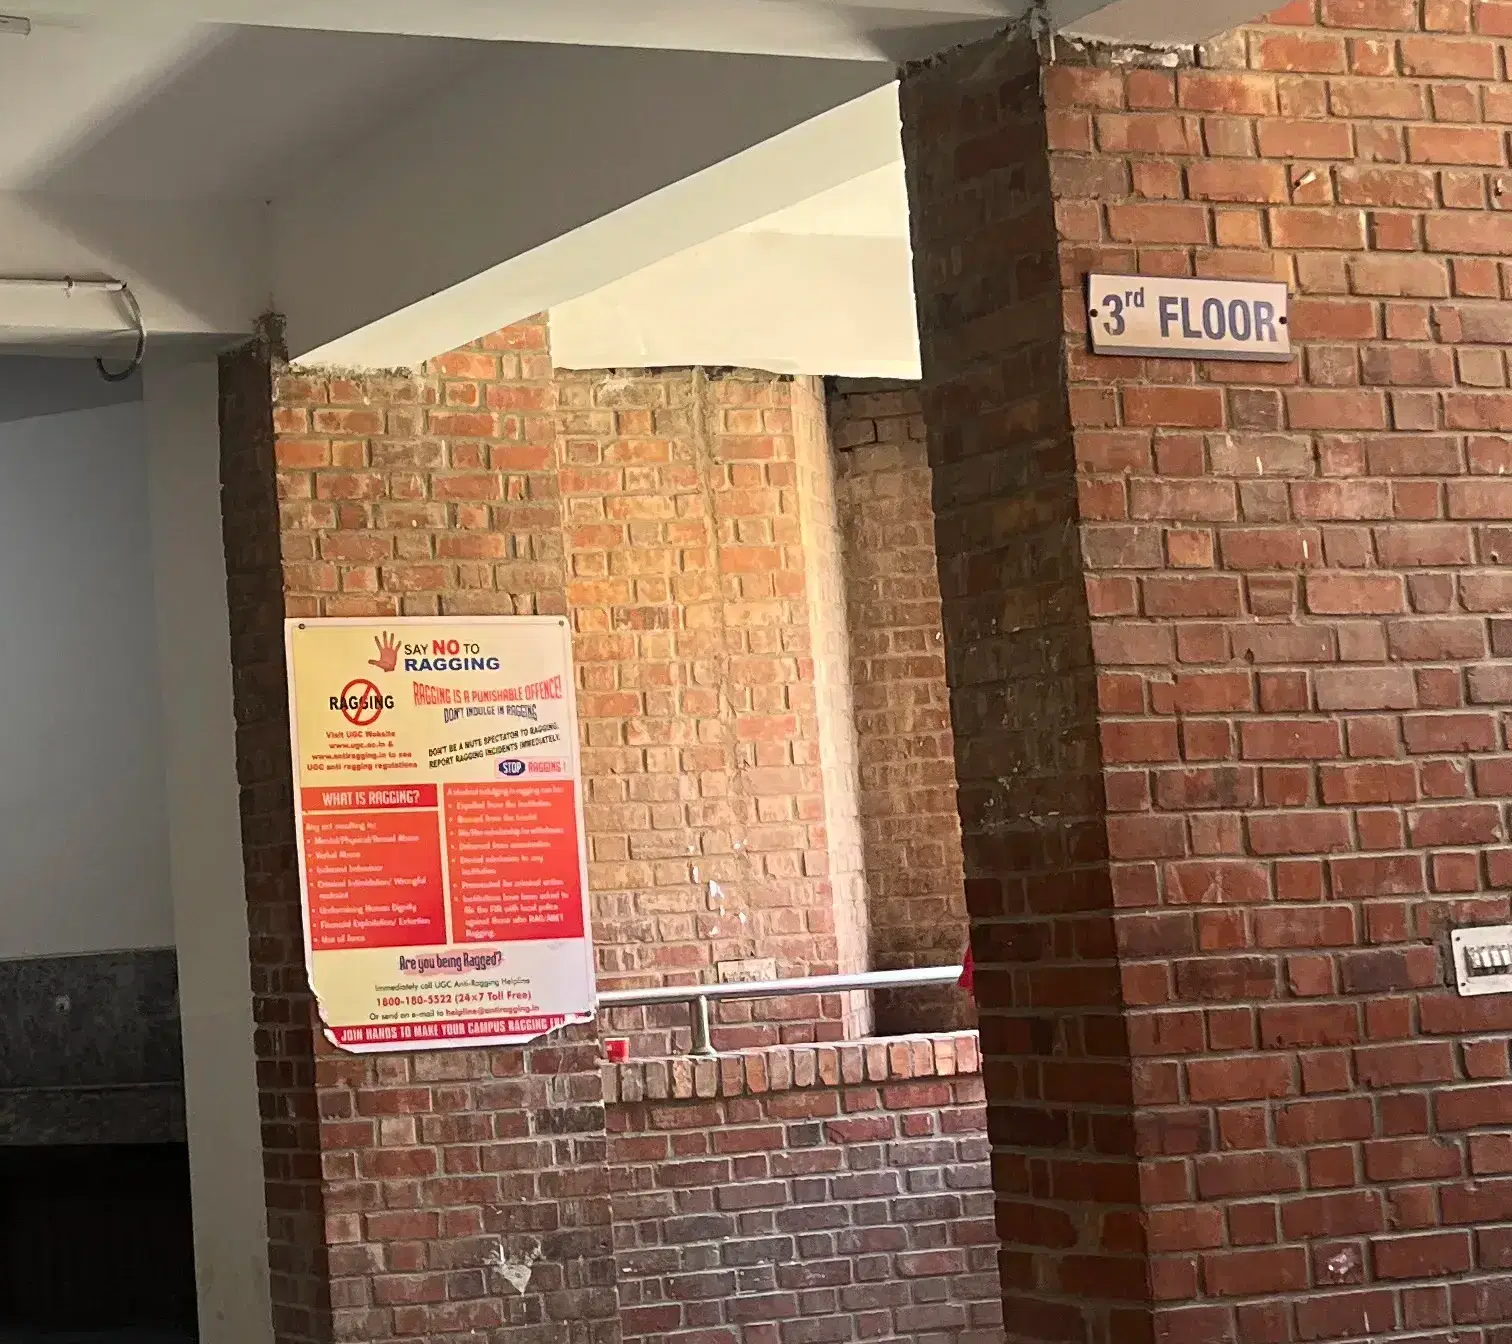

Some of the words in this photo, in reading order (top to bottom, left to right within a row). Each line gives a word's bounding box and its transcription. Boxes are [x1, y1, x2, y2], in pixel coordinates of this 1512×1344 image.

[1158, 295, 1277, 342] FLOOR
[404, 644, 428, 656] SAY
[432, 639, 460, 655] NO
[463, 643, 480, 655] TO
[404, 657, 500, 671] RAGGING
[413, 680, 451, 706] RAGGING
[453, 688, 462, 704] IS
[464, 690, 470, 703] A
[471, 686, 523, 703] PUNISHABLE
[524, 675, 563, 700] OFFENCE!
[329, 695, 395, 711] RAGGING
[444, 707, 464, 723] DON'T
[466, 706, 496, 718] INDULGE
[326, 731, 344, 739] Visit
[448, 742, 458, 752] BE
[459, 742, 464, 750] A
[483, 729, 519, 745] SPECTATOR
[520, 728, 529, 737] TO
[429, 758, 454, 769] REPORT
[455, 750, 484, 763] RAGGING
[485, 742, 518, 756] INCIDENTS
[307, 763, 325, 771] UGC
[343, 762, 373, 772] ragging
[503, 760, 522, 774] STOP
[322, 791, 353, 806] WHAT
[355, 791, 366, 805] IS
[368, 790, 420, 805] RAGGING?
[399, 955, 416, 970] Are
[418, 958, 435, 973] you
[436, 953, 462, 972] being
[463, 951, 502, 971] Ragged?
[375, 982, 418, 992] Immediately
[420, 981, 432, 990] call
[435, 980, 452, 989] UGC
[487, 990, 504, 1001] Toll
[507, 990, 532, 1001] Free)
[381, 1011, 399, 1020] send
[341, 1029, 363, 1042] JOIN
[365, 1026, 398, 1040] HANDS
[400, 1025, 411, 1038] TO
[413, 1024, 439, 1037] MAKE
[440, 1022, 466, 1036] YOUR
[467, 1020, 506, 1035] CAMPUS
[508, 1018, 548, 1033] RAGGING
